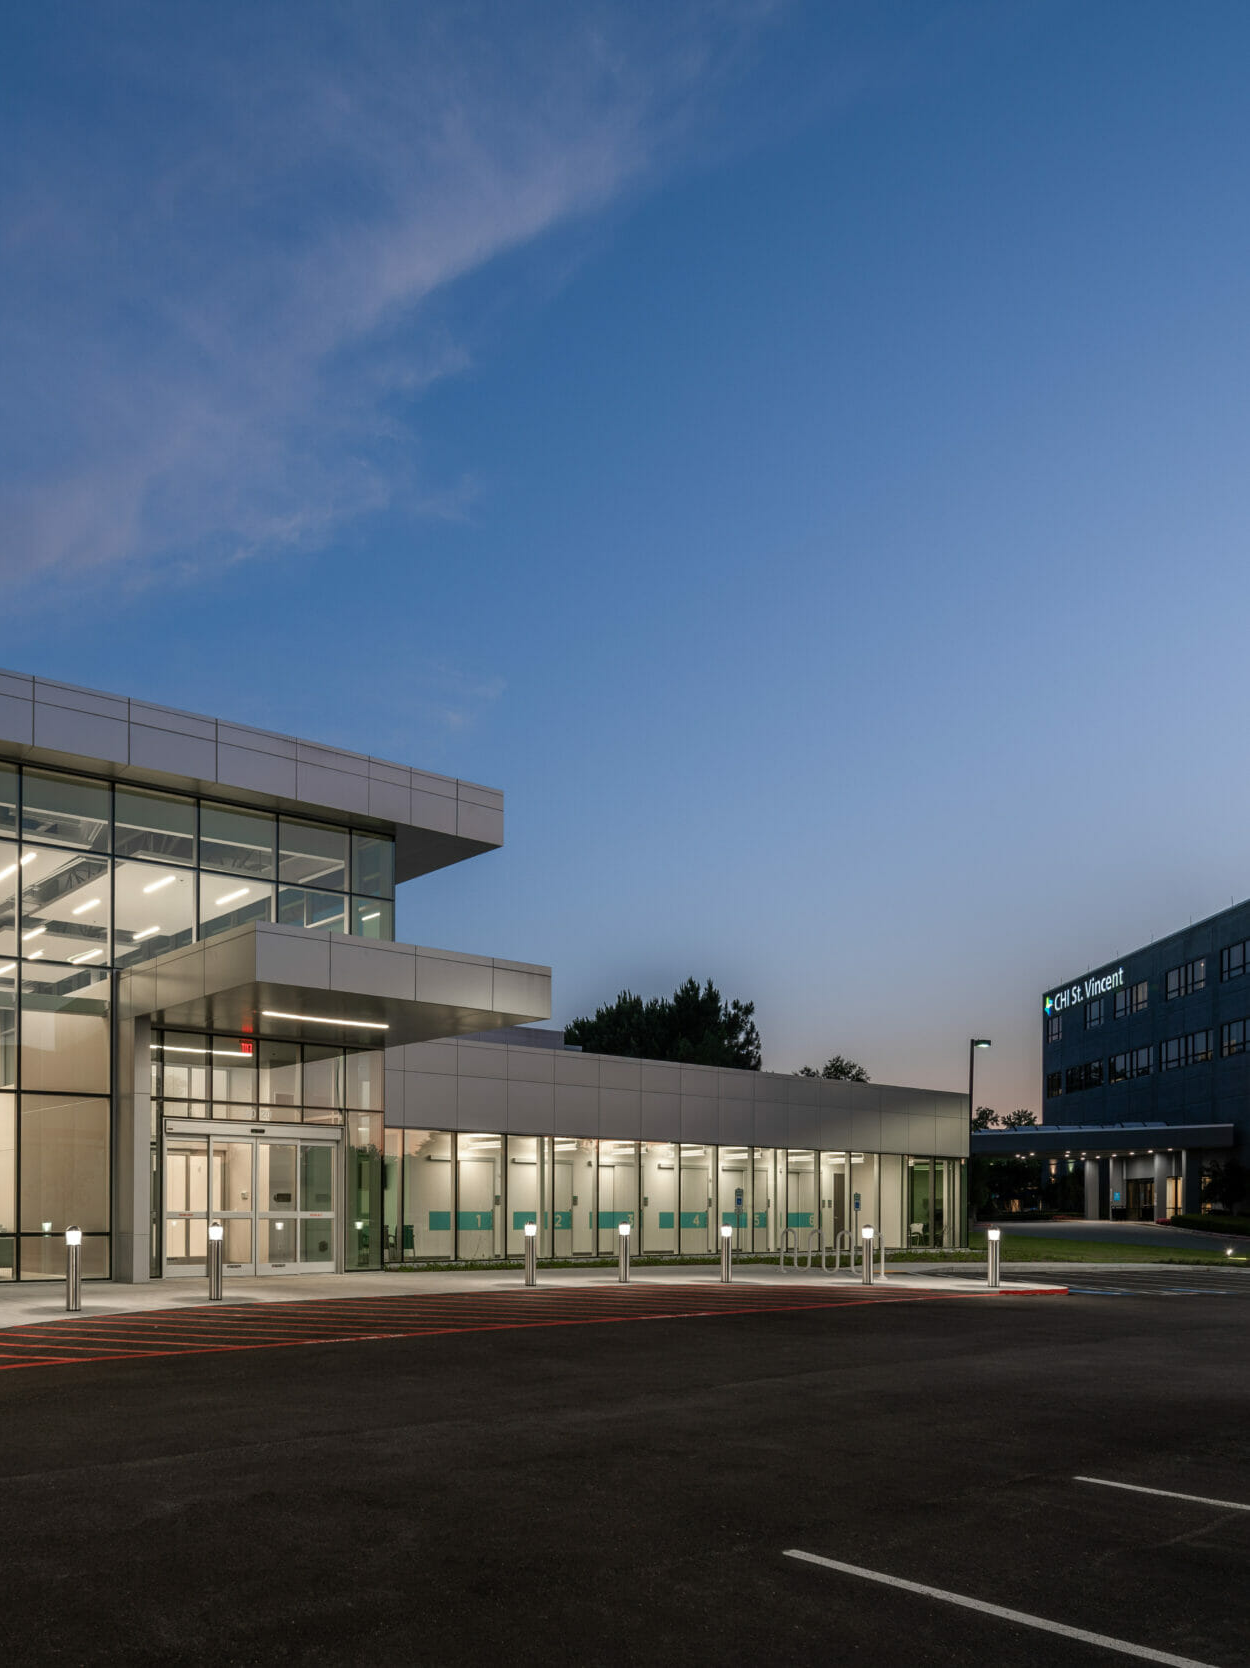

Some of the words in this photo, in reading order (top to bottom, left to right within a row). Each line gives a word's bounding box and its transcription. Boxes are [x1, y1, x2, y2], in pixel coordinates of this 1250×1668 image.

[1054, 989, 1070, 1011] CHI
[1071, 985, 1083, 1005] St.
[1084, 967, 1124, 998] Vincent
[476, 1214, 482, 1228] 1
[554, 1214, 562, 1227] 2
[693, 1214, 700, 1226] 4
